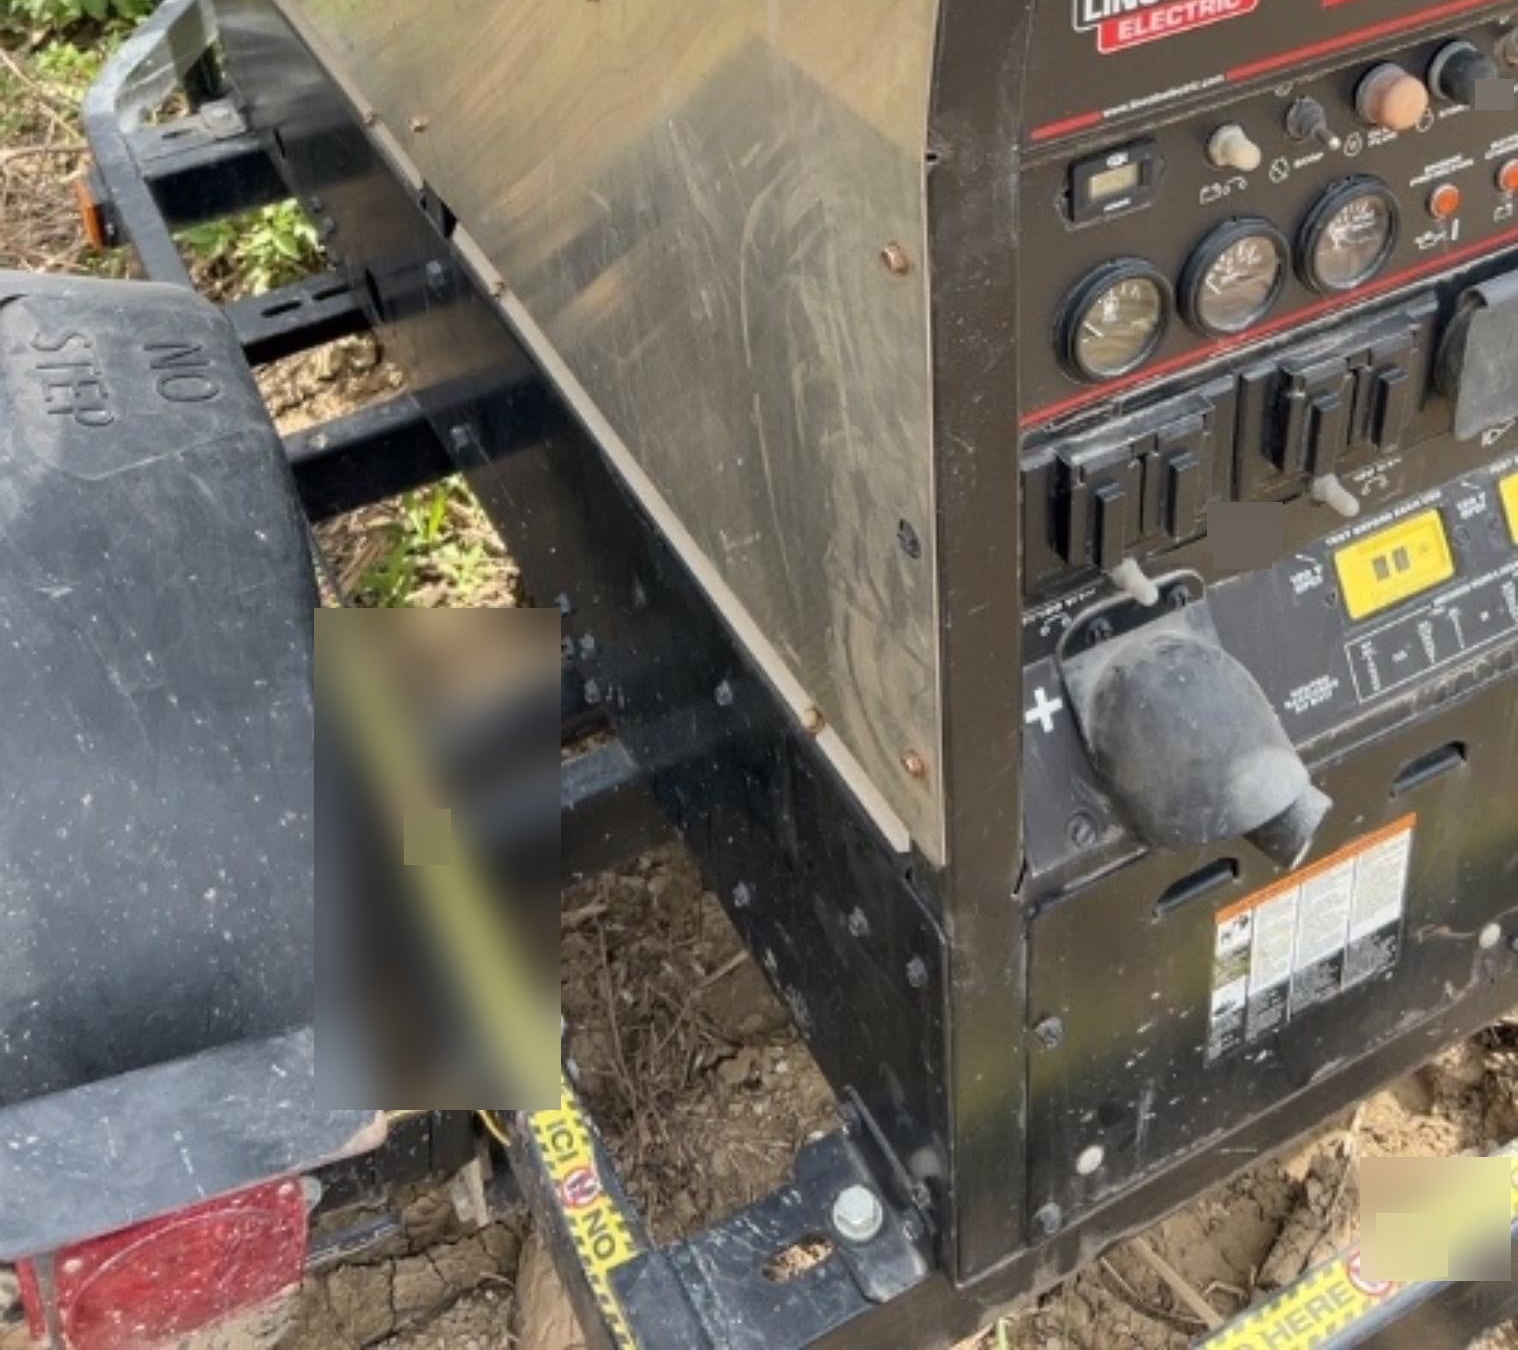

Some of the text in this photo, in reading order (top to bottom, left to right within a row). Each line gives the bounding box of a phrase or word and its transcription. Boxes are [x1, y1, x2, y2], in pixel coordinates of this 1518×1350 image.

[29, 331, 116, 427] STEP
[143, 343, 221, 402] NO
[581, 1208, 616, 1261] NO
[1261, 1278, 1357, 1349] HERE
